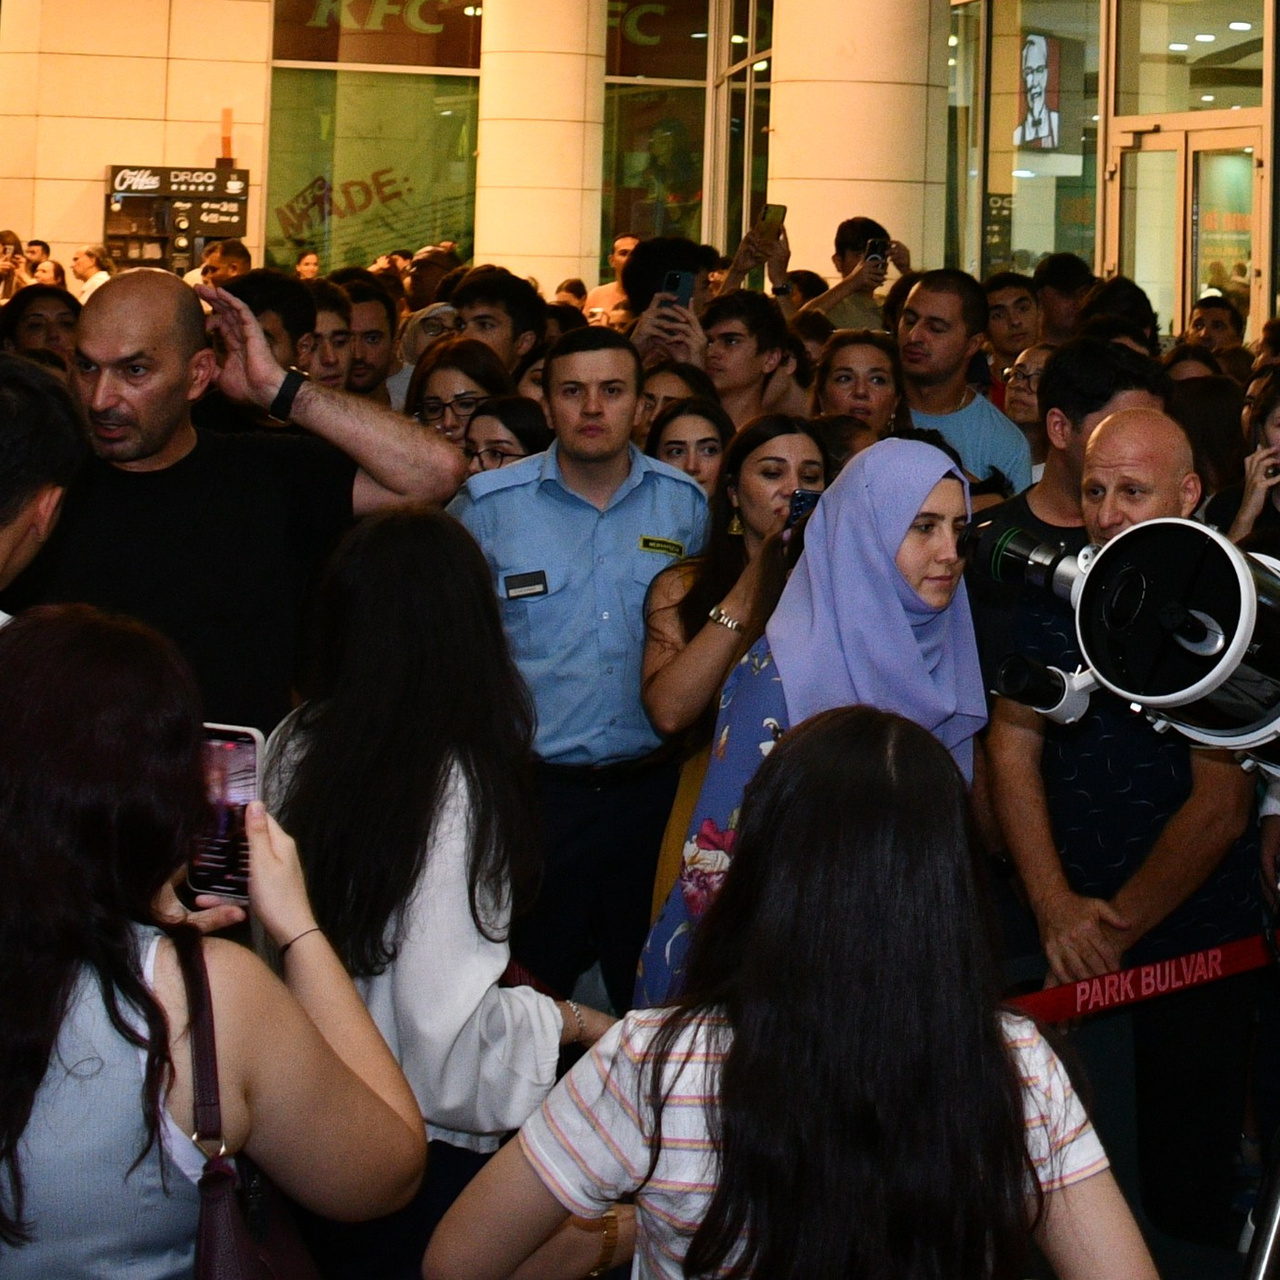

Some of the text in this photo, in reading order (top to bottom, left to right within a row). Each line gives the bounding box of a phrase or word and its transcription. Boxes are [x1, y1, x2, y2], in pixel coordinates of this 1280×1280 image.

[607, 1, 665, 46] FC
[1075, 948, 1223, 1013] PARK BULVAR
